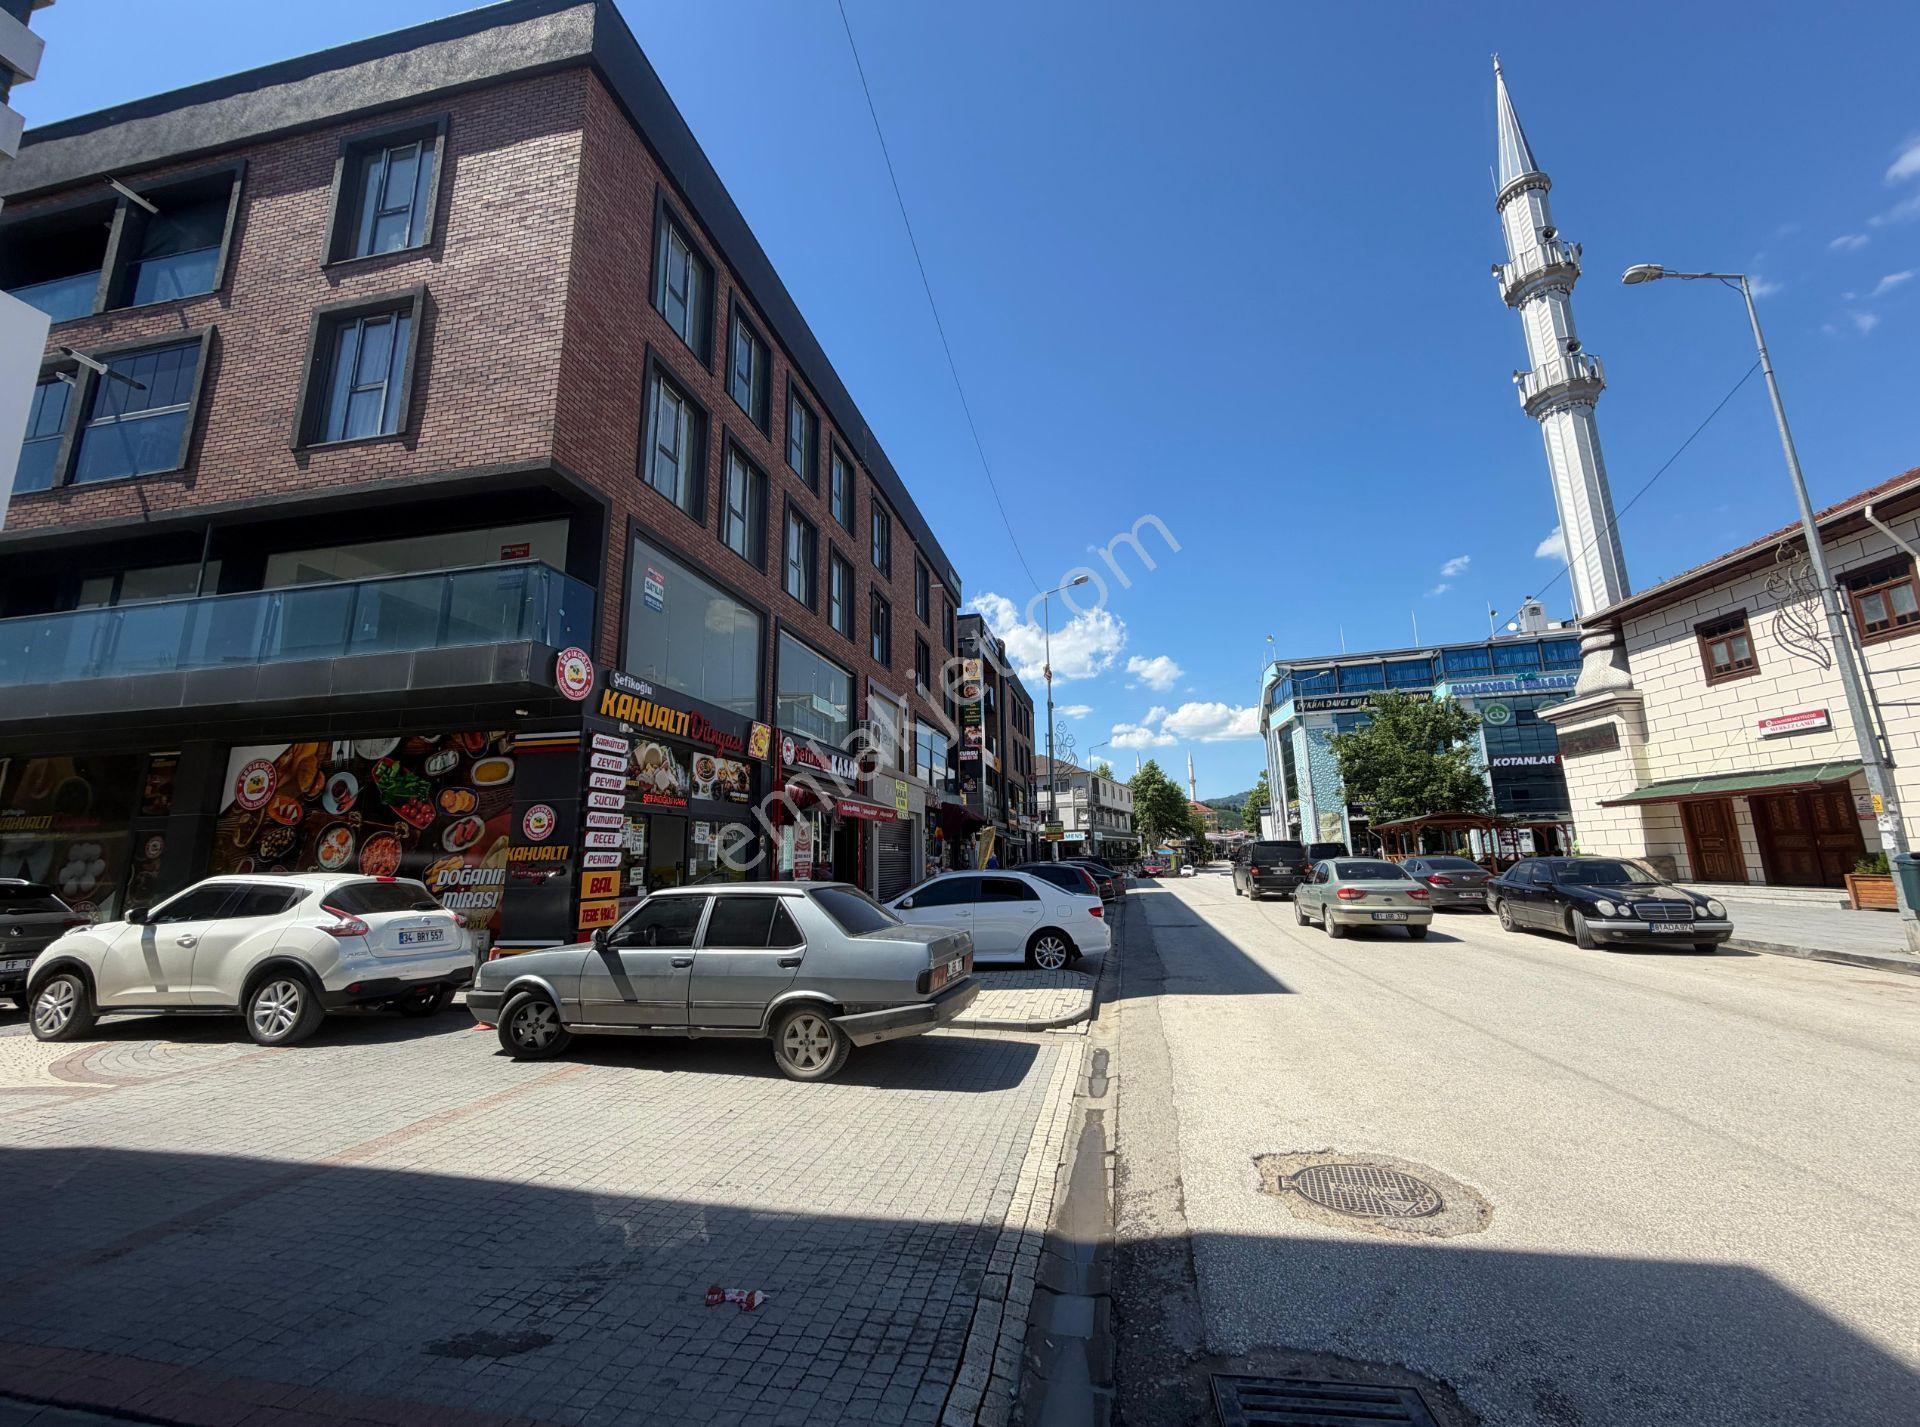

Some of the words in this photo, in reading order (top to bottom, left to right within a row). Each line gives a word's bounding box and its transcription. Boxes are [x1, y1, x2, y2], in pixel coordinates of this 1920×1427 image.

[614, 672, 653, 695] Şefikoğlu
[597, 757, 622, 770] ZEYTİN
[1493, 755, 1556, 767] KOTANLAR
[594, 776, 622, 789] PEYNİR
[593, 794, 620, 807] SUCUK
[588, 814, 622, 826] YUMURTA
[592, 833, 616, 846] REÇEL
[587, 854, 617, 865] PEKMEZ
[590, 877, 612, 894] BAL
[442, 887, 500, 908] MİRASI
[582, 908, 599, 923] TERE
[403, 933, 413, 942] 34
[417, 931, 429, 941] BRY
[431, 930, 443, 939] 557
[5, 960, 17, 969] FF
